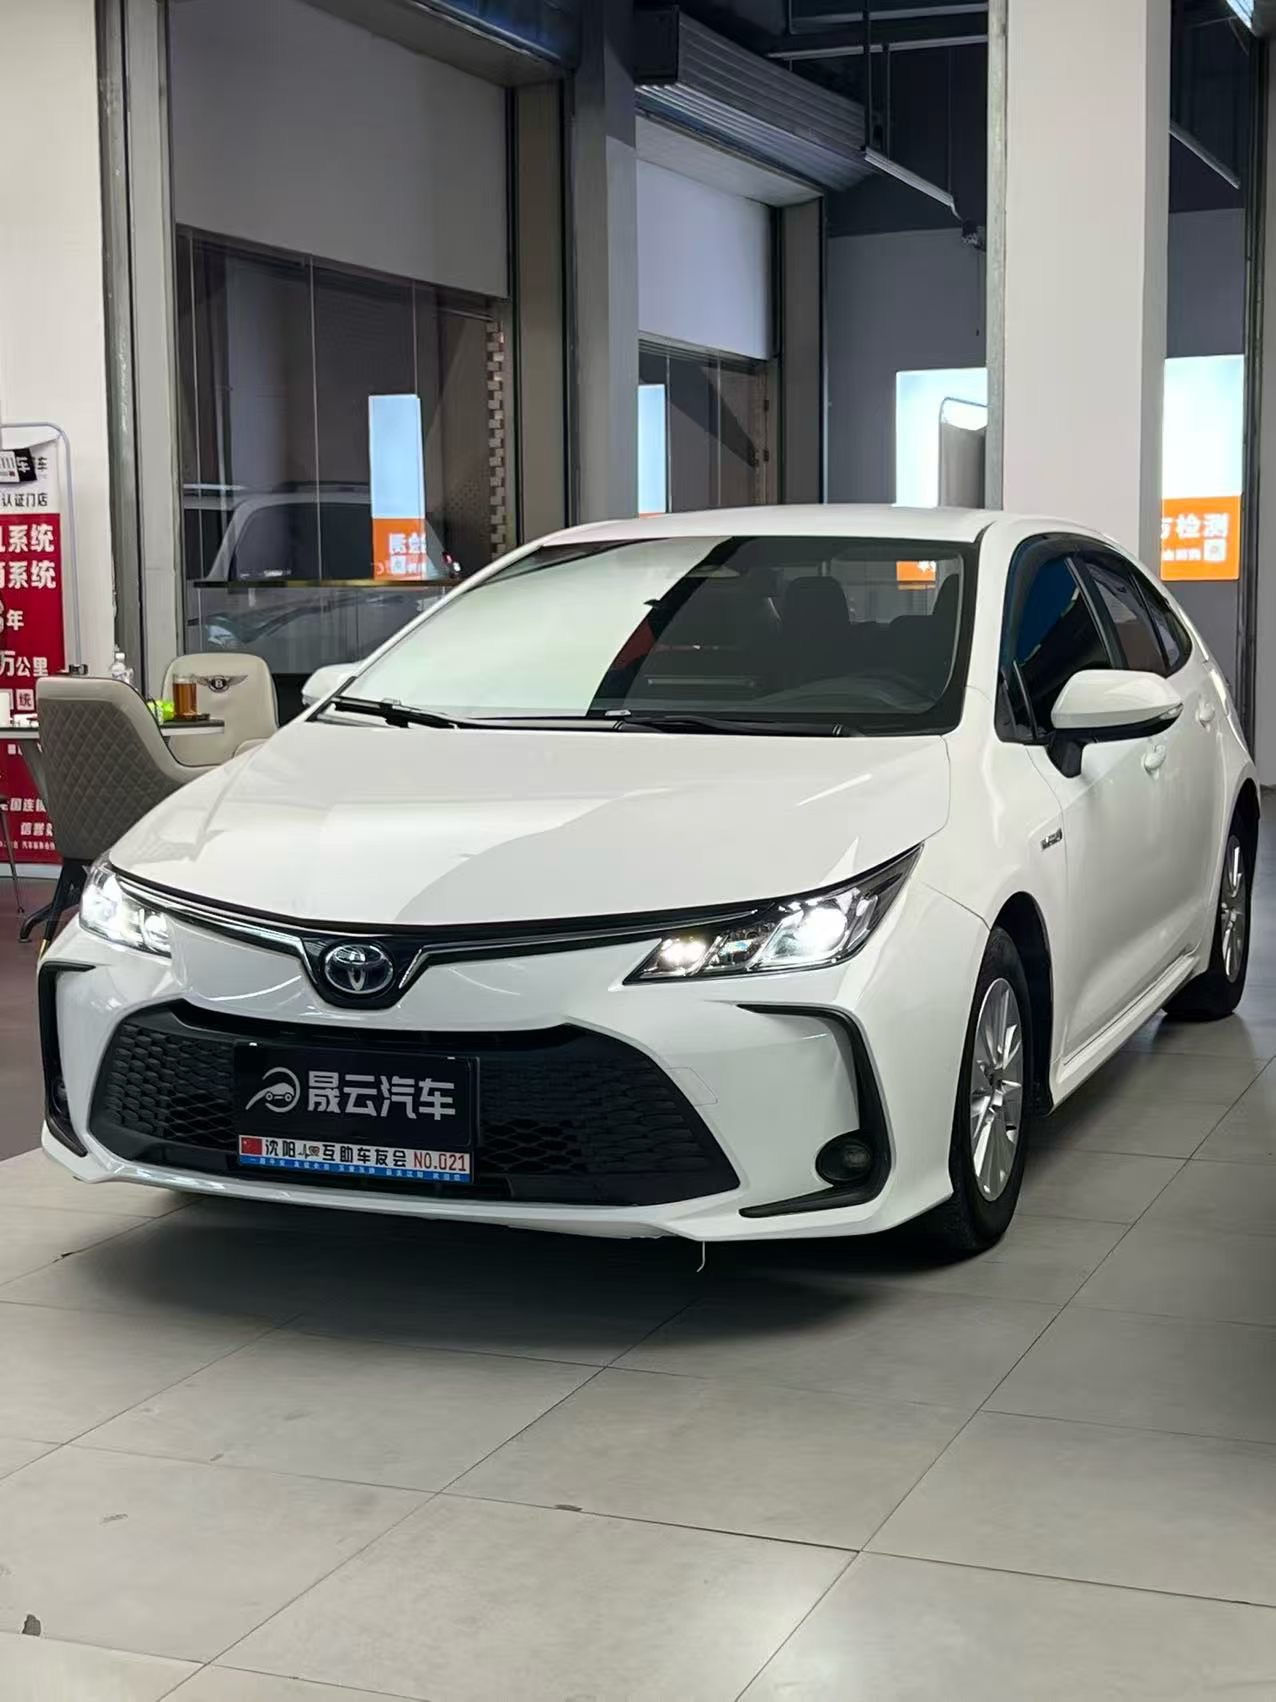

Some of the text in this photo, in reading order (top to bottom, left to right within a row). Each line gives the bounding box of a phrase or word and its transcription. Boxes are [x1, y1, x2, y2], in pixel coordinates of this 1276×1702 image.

[3, 493, 48, 507] 认证门店
[0, 524, 54, 552] 系统
[0, 560, 56, 589] 系统
[307, 1070, 455, 1120] 晟云汽车
[265, 1139, 296, 1158] 沈阳
[322, 1144, 407, 1168] 互助车友会
